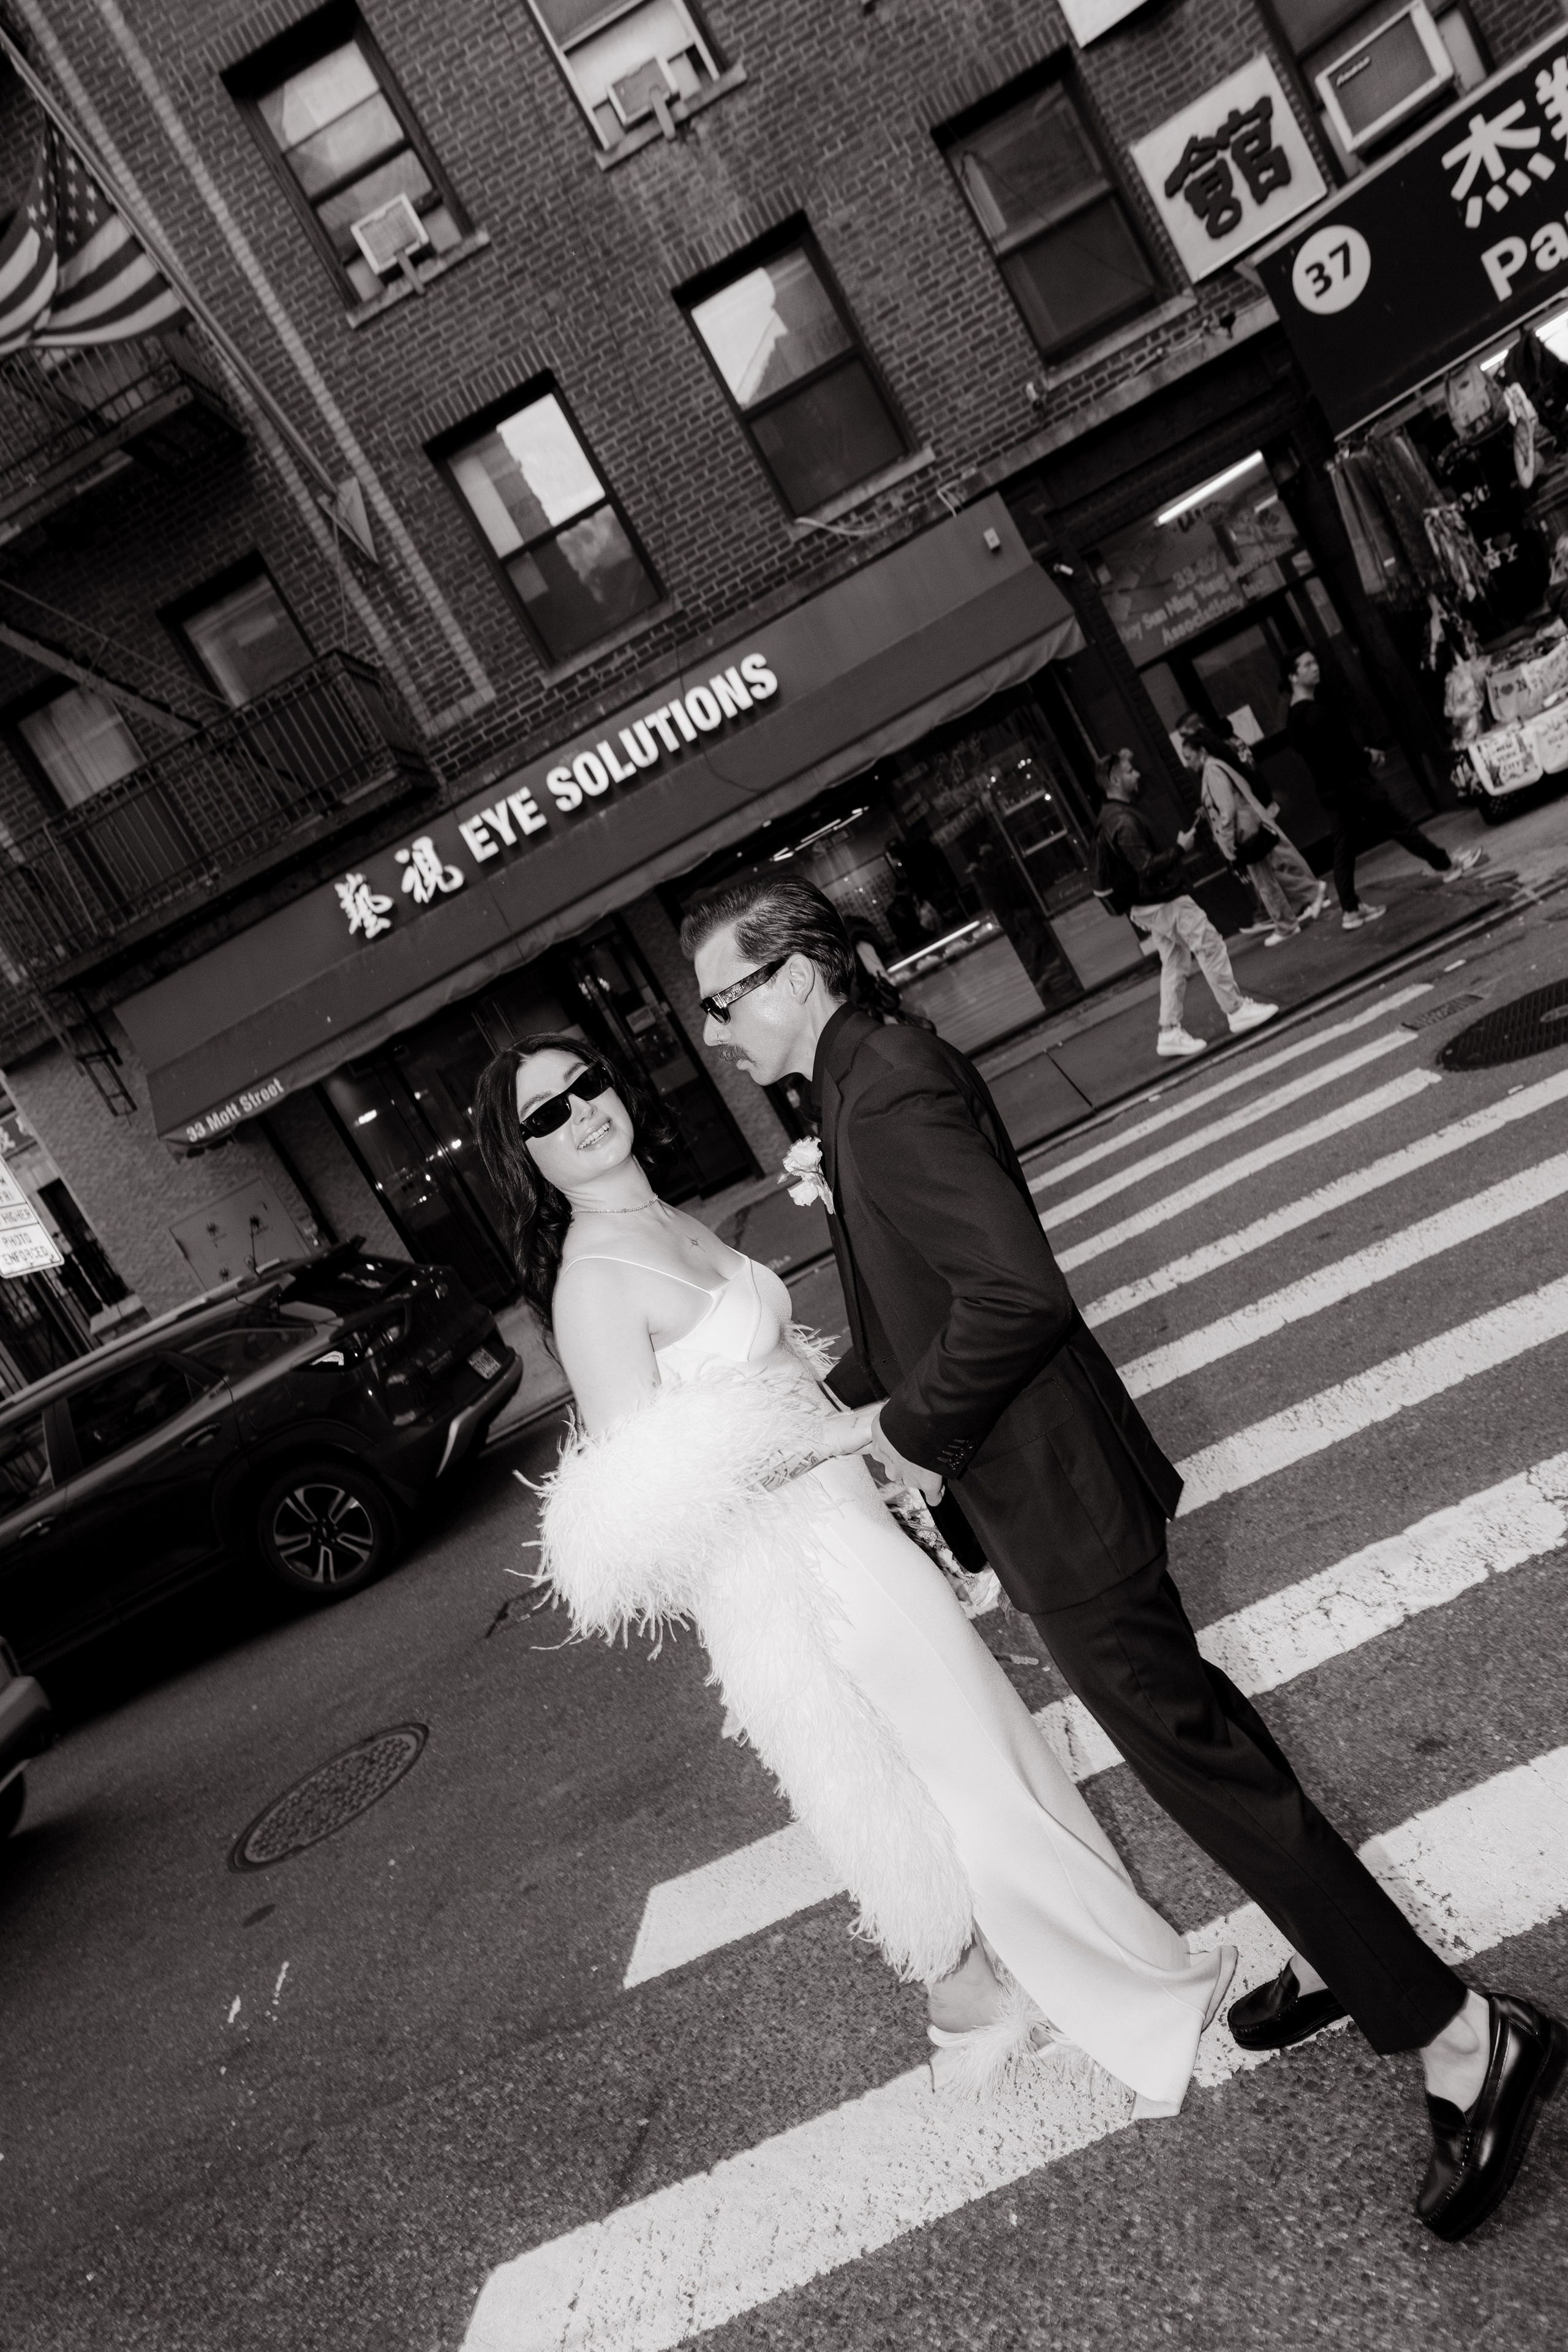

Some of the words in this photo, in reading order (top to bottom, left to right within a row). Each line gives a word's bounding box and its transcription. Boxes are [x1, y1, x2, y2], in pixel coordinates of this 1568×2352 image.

[1305, 241, 1351, 298] 37
[1481, 211, 1568, 302] Pa
[458, 786, 548, 864] EYE
[545, 652, 779, 813] SOLUTIONS
[185, 1122, 206, 1142] 33
[205, 1102, 243, 1133] Mott
[238, 1078, 285, 1114] Street
[1, 1208, 31, 1224] HIGHER
[2, 1232, 32, 1249] PHOTO
[2, 1245, 49, 1266] ENFORCED
